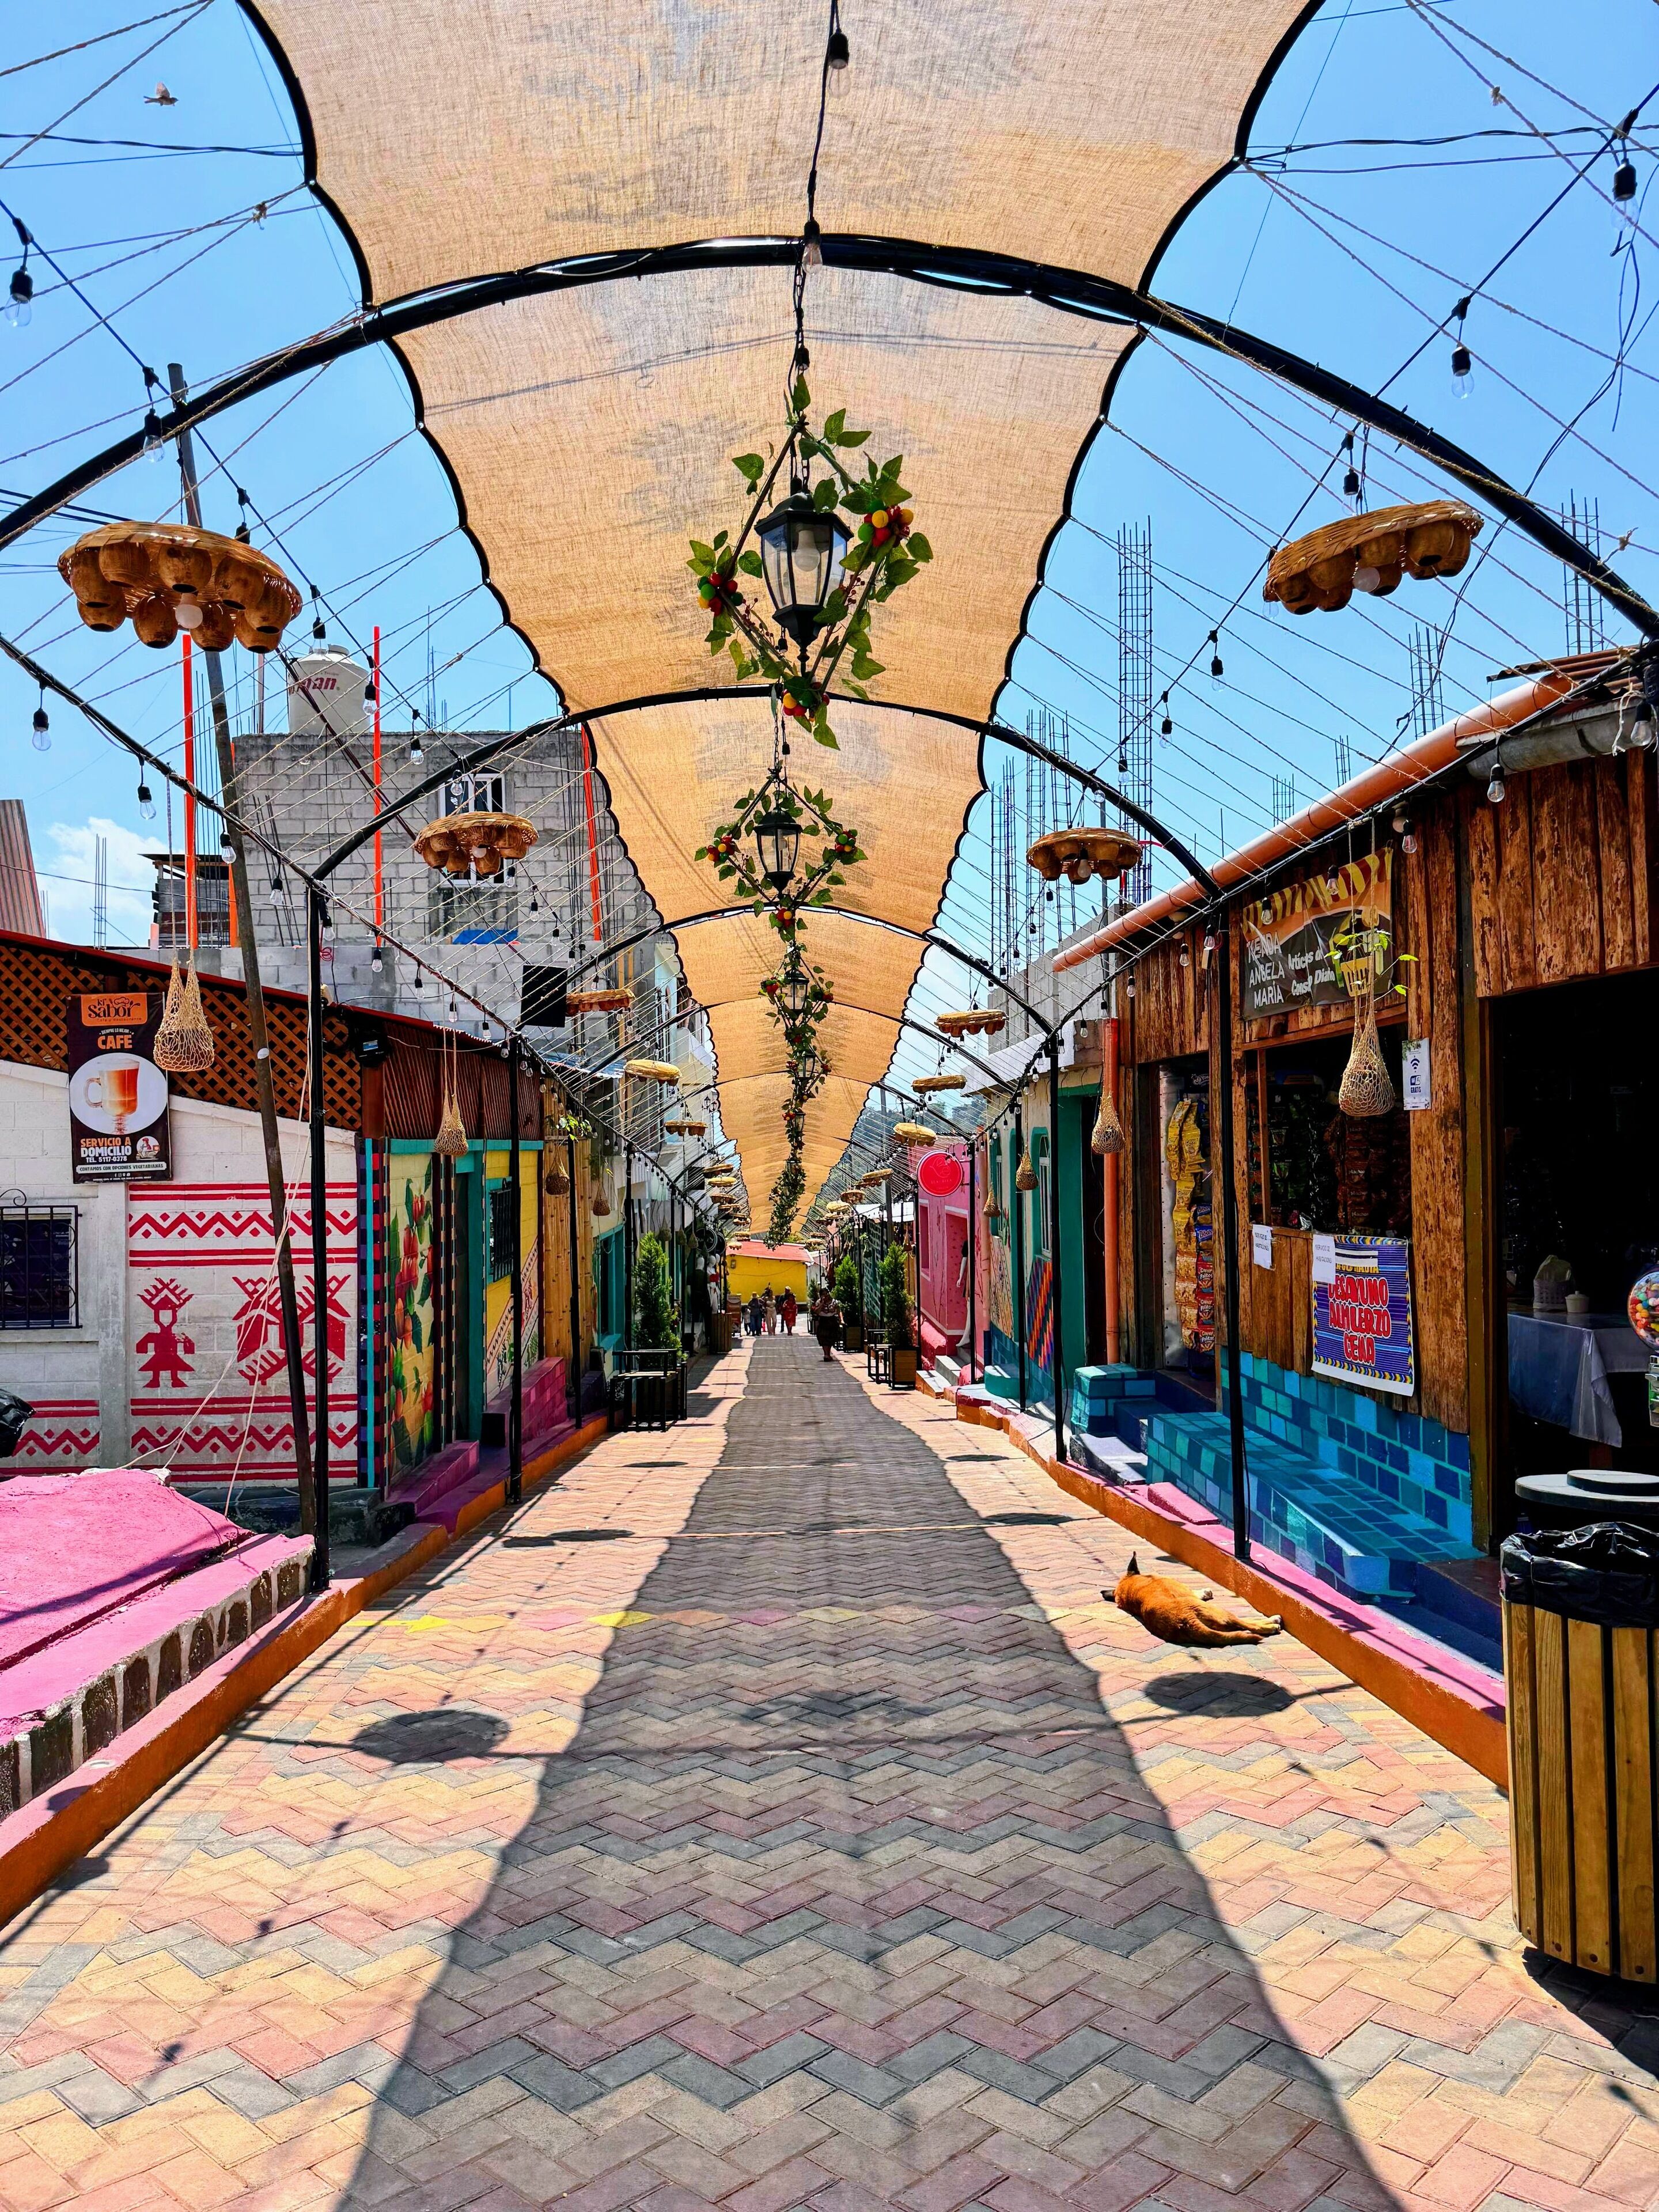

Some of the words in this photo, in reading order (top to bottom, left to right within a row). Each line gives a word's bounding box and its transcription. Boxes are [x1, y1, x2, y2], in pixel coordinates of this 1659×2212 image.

[1249, 960, 1285, 988] ANGELA
[1254, 980, 1284, 1009] MARÍA
[81, 1137, 122, 1147] SERVICIO
[124, 1137, 131, 1146] A
[81, 1146, 132, 1157] DOMICILIO
[1328, 1273, 1389, 1308] DESAYUNO
[1328, 1301, 1392, 1339] ALMUERZO
[1343, 1332, 1376, 1366] CENA
